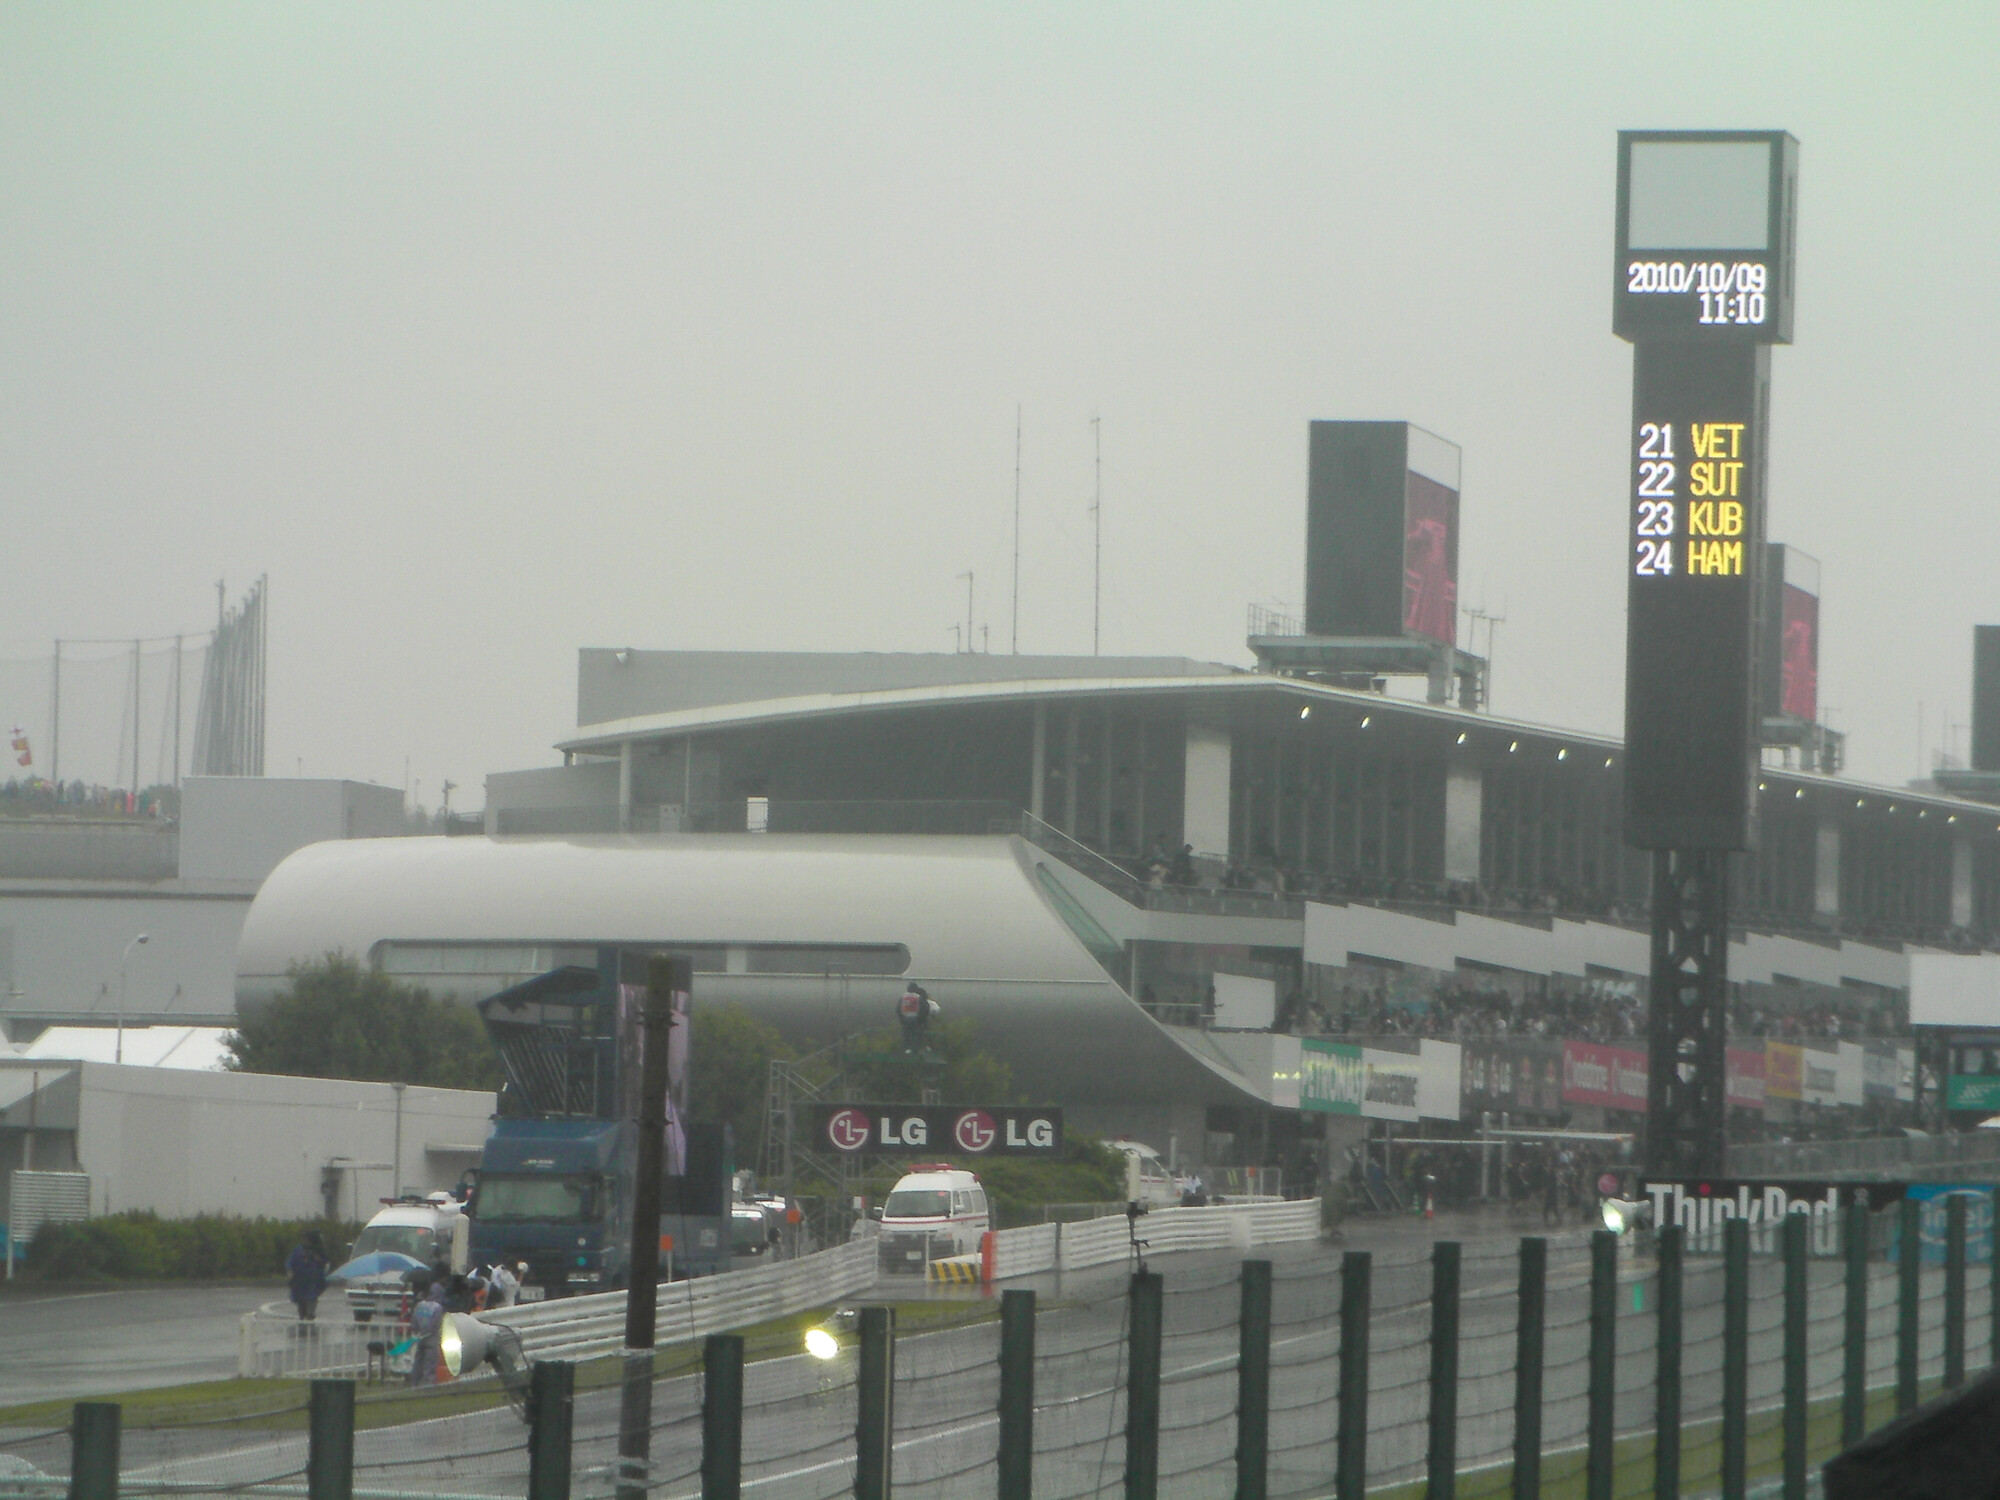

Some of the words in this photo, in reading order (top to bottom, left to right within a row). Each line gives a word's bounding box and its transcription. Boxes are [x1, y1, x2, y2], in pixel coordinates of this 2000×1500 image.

[1628, 262, 1767, 293] 2010/10/09
[1699, 292, 1766, 324] 11:10
[1638, 423, 1675, 459] 21
[1690, 423, 1745, 459] VET
[1637, 461, 1675, 497] 22
[1689, 461, 1744, 497] SUT
[1637, 500, 1674, 536] 23
[1688, 500, 1743, 536] KUB
[1635, 539, 1673, 575] 24
[1687, 539, 1743, 576] HAM
[880, 1117, 927, 1146] LG
[1006, 1119, 1053, 1147] LG
